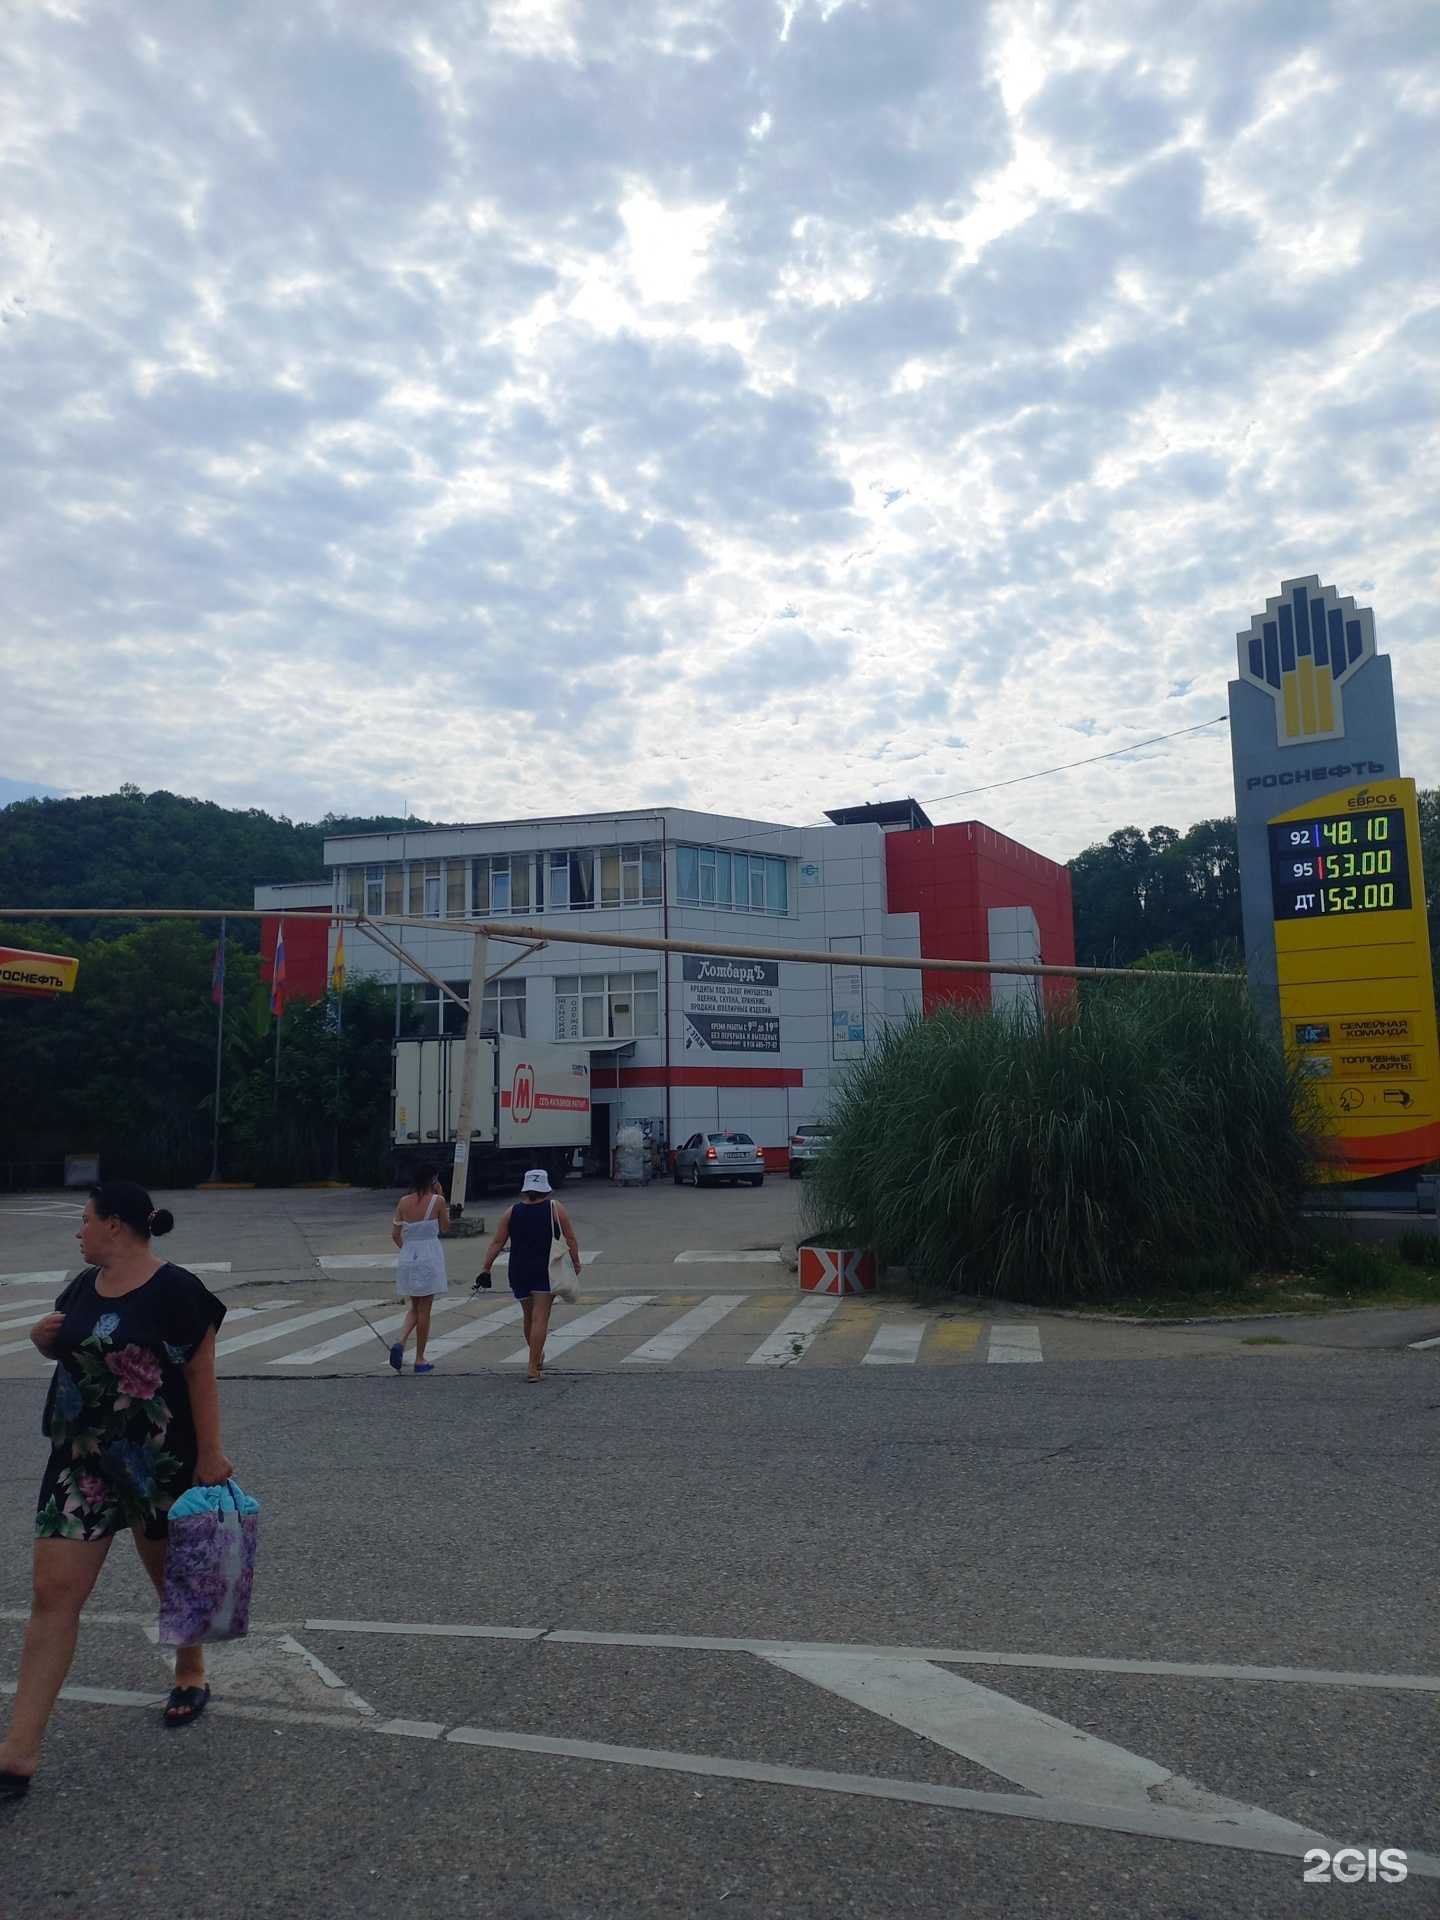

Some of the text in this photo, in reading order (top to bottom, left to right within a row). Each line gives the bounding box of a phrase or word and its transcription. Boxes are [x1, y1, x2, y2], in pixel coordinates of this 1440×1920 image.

[1247, 761, 1385, 791] РОСНЕФТЬ
[1290, 816, 1388, 846] 92 48.10
[1293, 850, 1391, 879] 95 53.00
[1294, 883, 1394, 911] ДТ 52.00
[0, 969, 63, 987] ОСНЕФТЬ
[1340, 1020, 1408, 1030] СЕМЕЙНАЯ
[1345, 1028, 1408, 1038] КОМАНДА
[1341, 1054, 1410, 1064] ТОПЛИВНЫЕ
[1370, 1062, 1413, 1071] КАРТЫ
